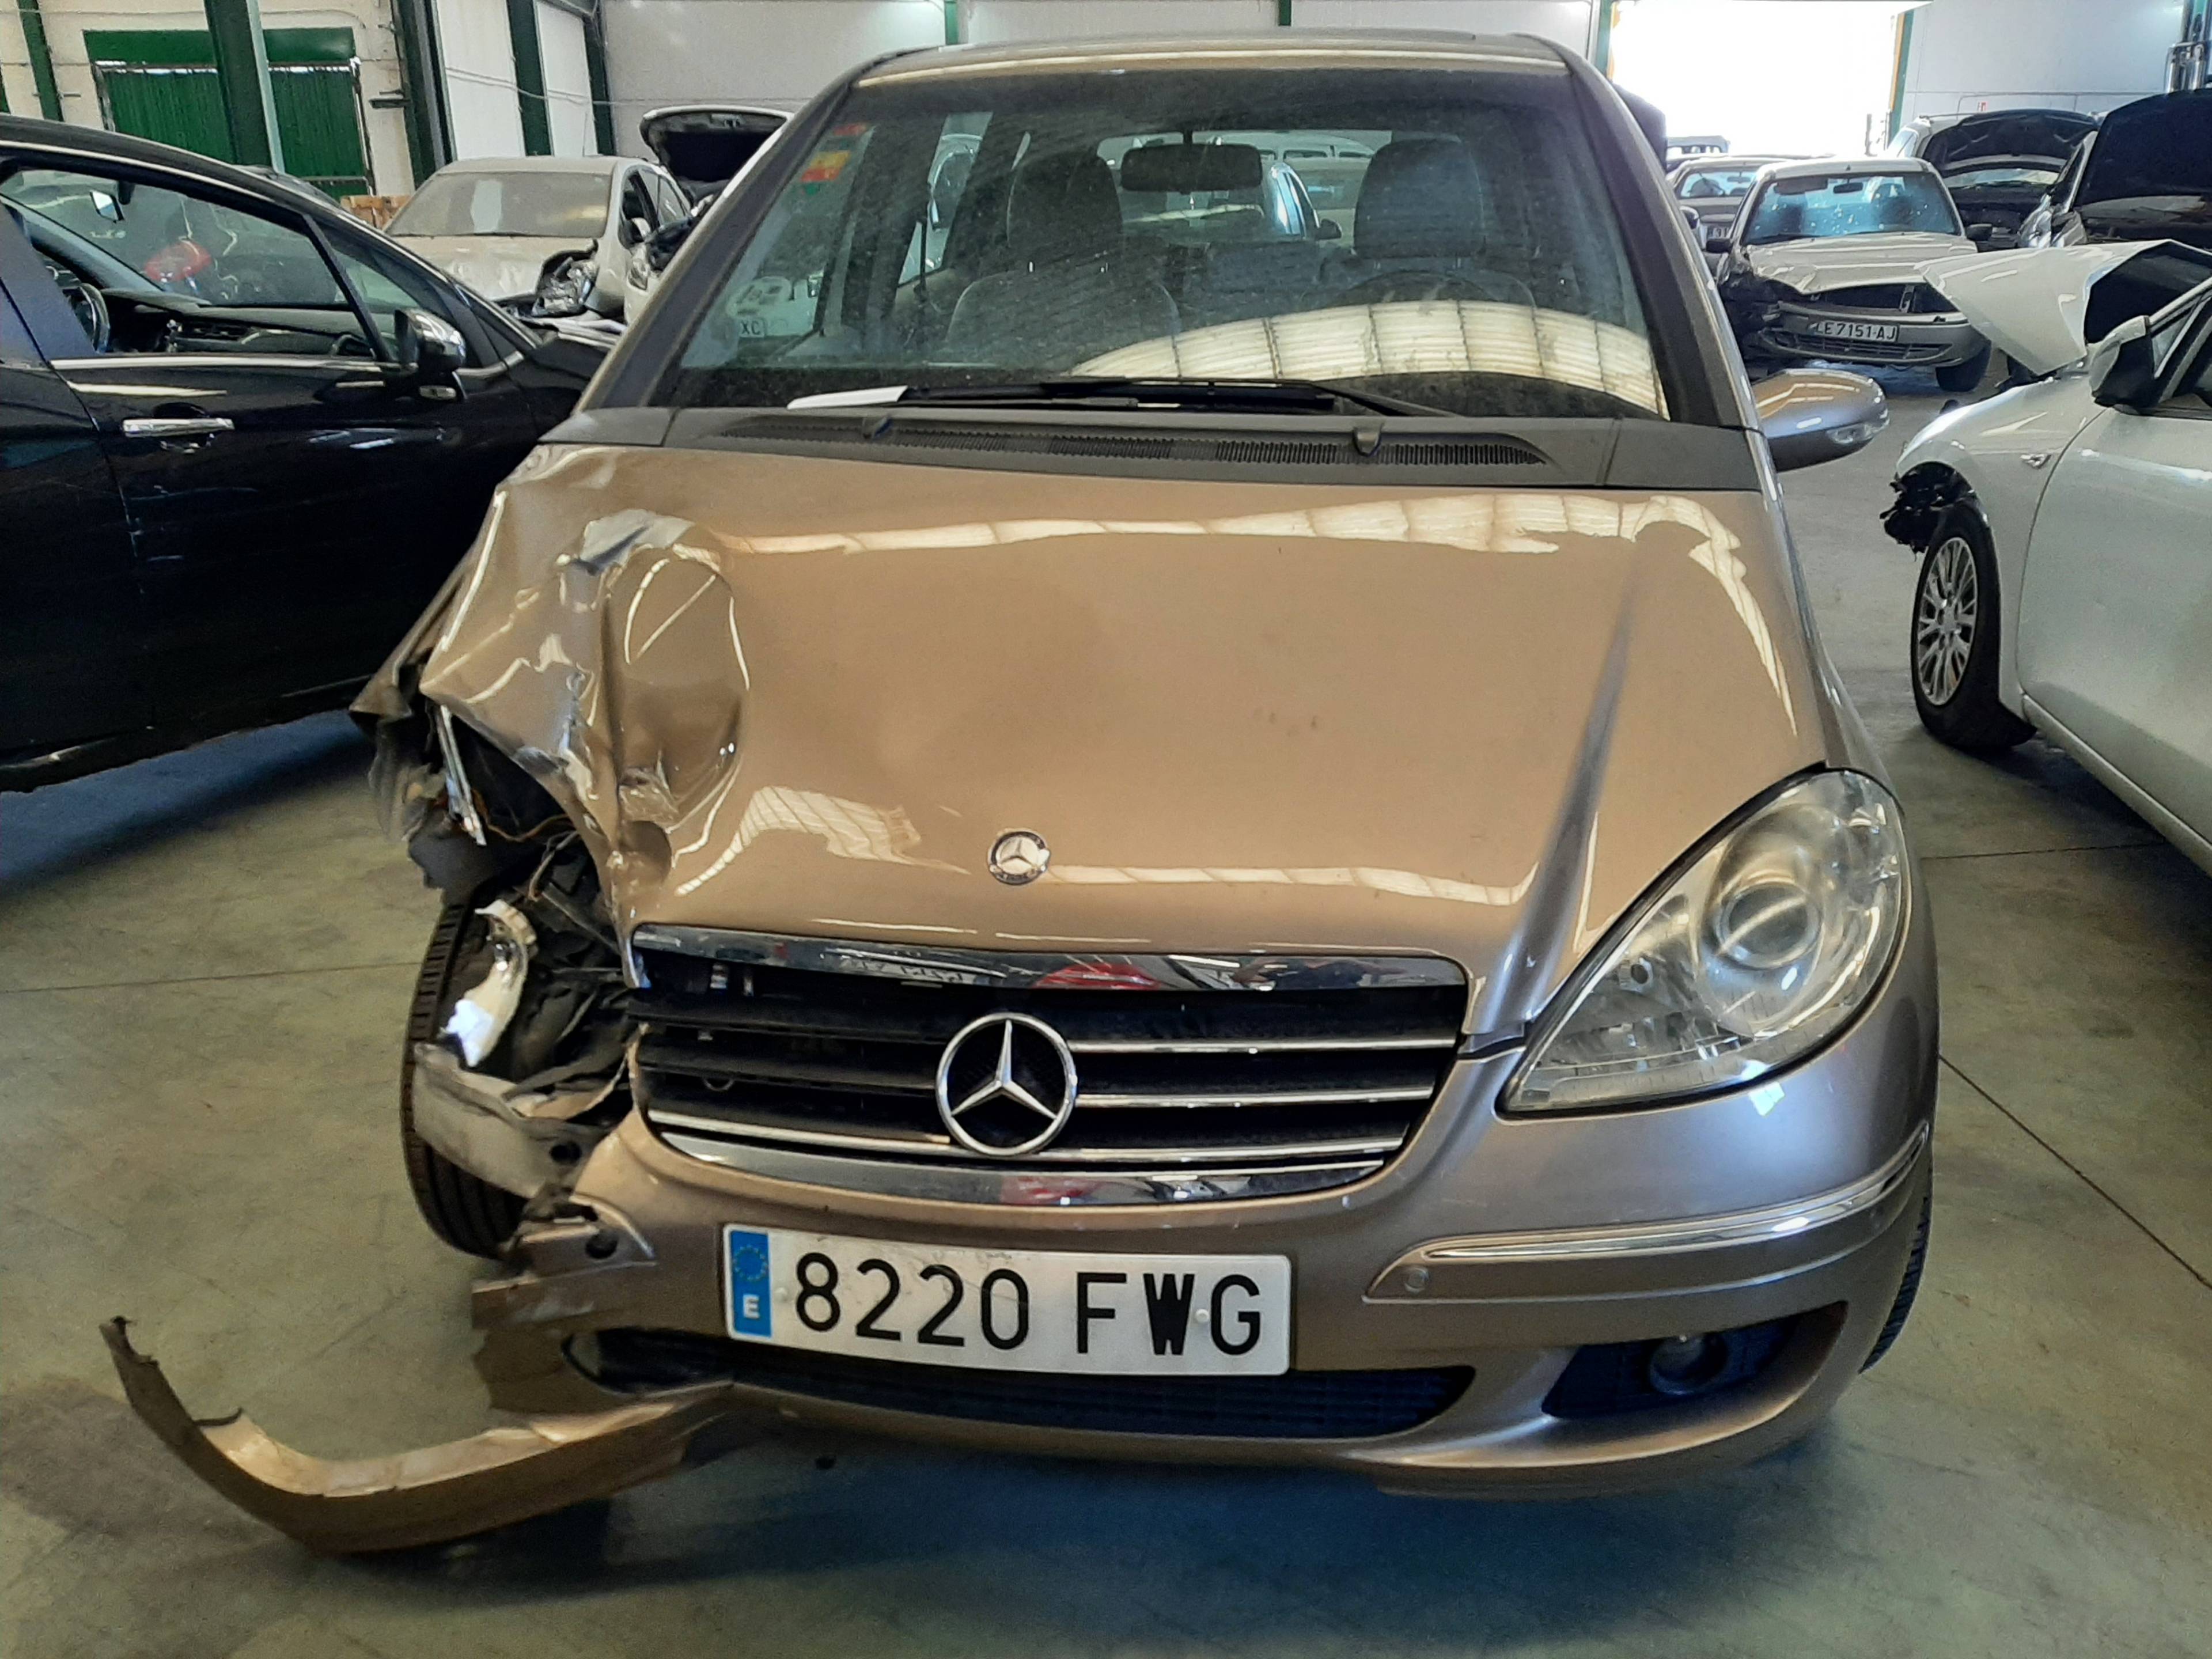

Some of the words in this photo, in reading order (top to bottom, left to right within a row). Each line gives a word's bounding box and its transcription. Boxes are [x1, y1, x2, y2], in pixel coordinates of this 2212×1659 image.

[743, 1294, 759, 1319] E
[795, 1252, 1029, 1350] 8220
[1077, 1272, 1261, 1356] FWG
